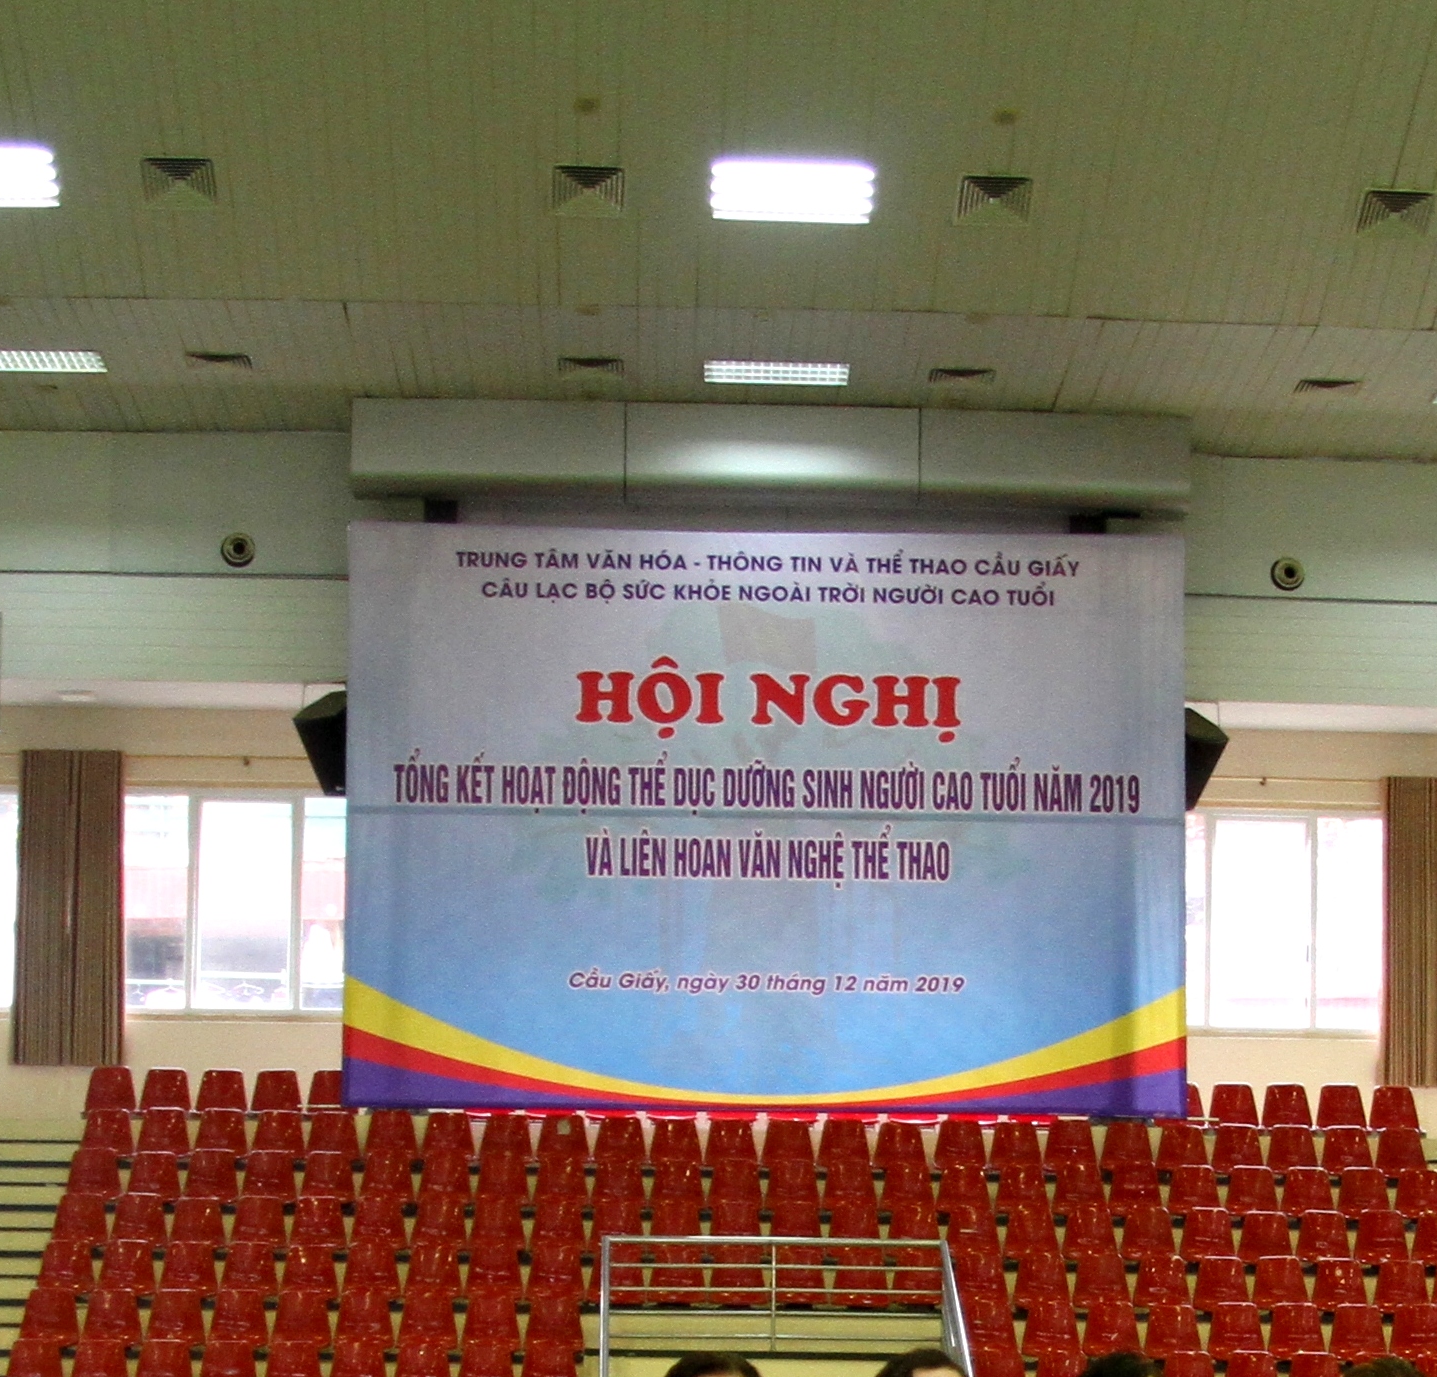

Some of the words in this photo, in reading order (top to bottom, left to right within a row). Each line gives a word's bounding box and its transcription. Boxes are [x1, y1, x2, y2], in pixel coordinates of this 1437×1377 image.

[456, 551, 527, 568] TRUNG
[534, 548, 579, 569] TÂM
[586, 549, 632, 570] VĂN
[639, 549, 687, 570] HÓA
[706, 551, 782, 572] THÔNG
[790, 556, 822, 573] TIN
[829, 552, 859, 573] VÀ
[866, 549, 905, 574] THỂ
[909, 558, 967, 575] THAO
[974, 551, 1021, 576] CẦU
[1028, 553, 1080, 577] GIẤY
[481, 578, 528, 599] CÂU
[536, 582, 578, 603] LẠC
[586, 579, 615, 604] BỘ
[622, 580, 665, 600] SỨC
[674, 579, 731, 601] KHỎE
[739, 581, 811, 602] NGOÀI
[818, 582, 865, 603] TRỜI
[873, 584, 943, 604] NGƯỜI
[951, 588, 1000, 605] CAO
[1006, 581, 1055, 606] TUỔI
[575, 655, 725, 740] HỘI
[749, 672, 962, 744] NGHỊ
[393, 748, 450, 804] TỔNG
[456, 752, 495, 804] KẾT
[501, 764, 556, 815] HOẠT
[563, 757, 621, 815] ĐỘNG
[628, 751, 668, 807] THỂ
[673, 767, 715, 816] DỤC
[723, 759, 795, 808] DƯỠNG
[802, 769, 853, 809] SINH
[859, 760, 925, 811] NGƯỜI
[932, 770, 973, 811] CAO
[979, 757, 1027, 812] TUỔI
[1033, 764, 1083, 813] NĂM
[1089, 773, 1140, 814] 2019
[585, 827, 613, 878] VÀ
[619, 828, 667, 878] LIÊN
[673, 838, 732, 878] HOAN
[738, 829, 781, 878] VĂN
[788, 831, 845, 890] NGHỆ
[851, 824, 892, 880] THỂ
[896, 840, 951, 881] THAO
[568, 967, 612, 989] Cầu
[618, 967, 669, 992] Giấy,
[676, 971, 729, 994] ngày
[735, 974, 761, 990] 30
[765, 972, 826, 995] tháng
[834, 974, 856, 992] 12
[863, 975, 908, 992] năm
[915, 976, 965, 993] 2019
